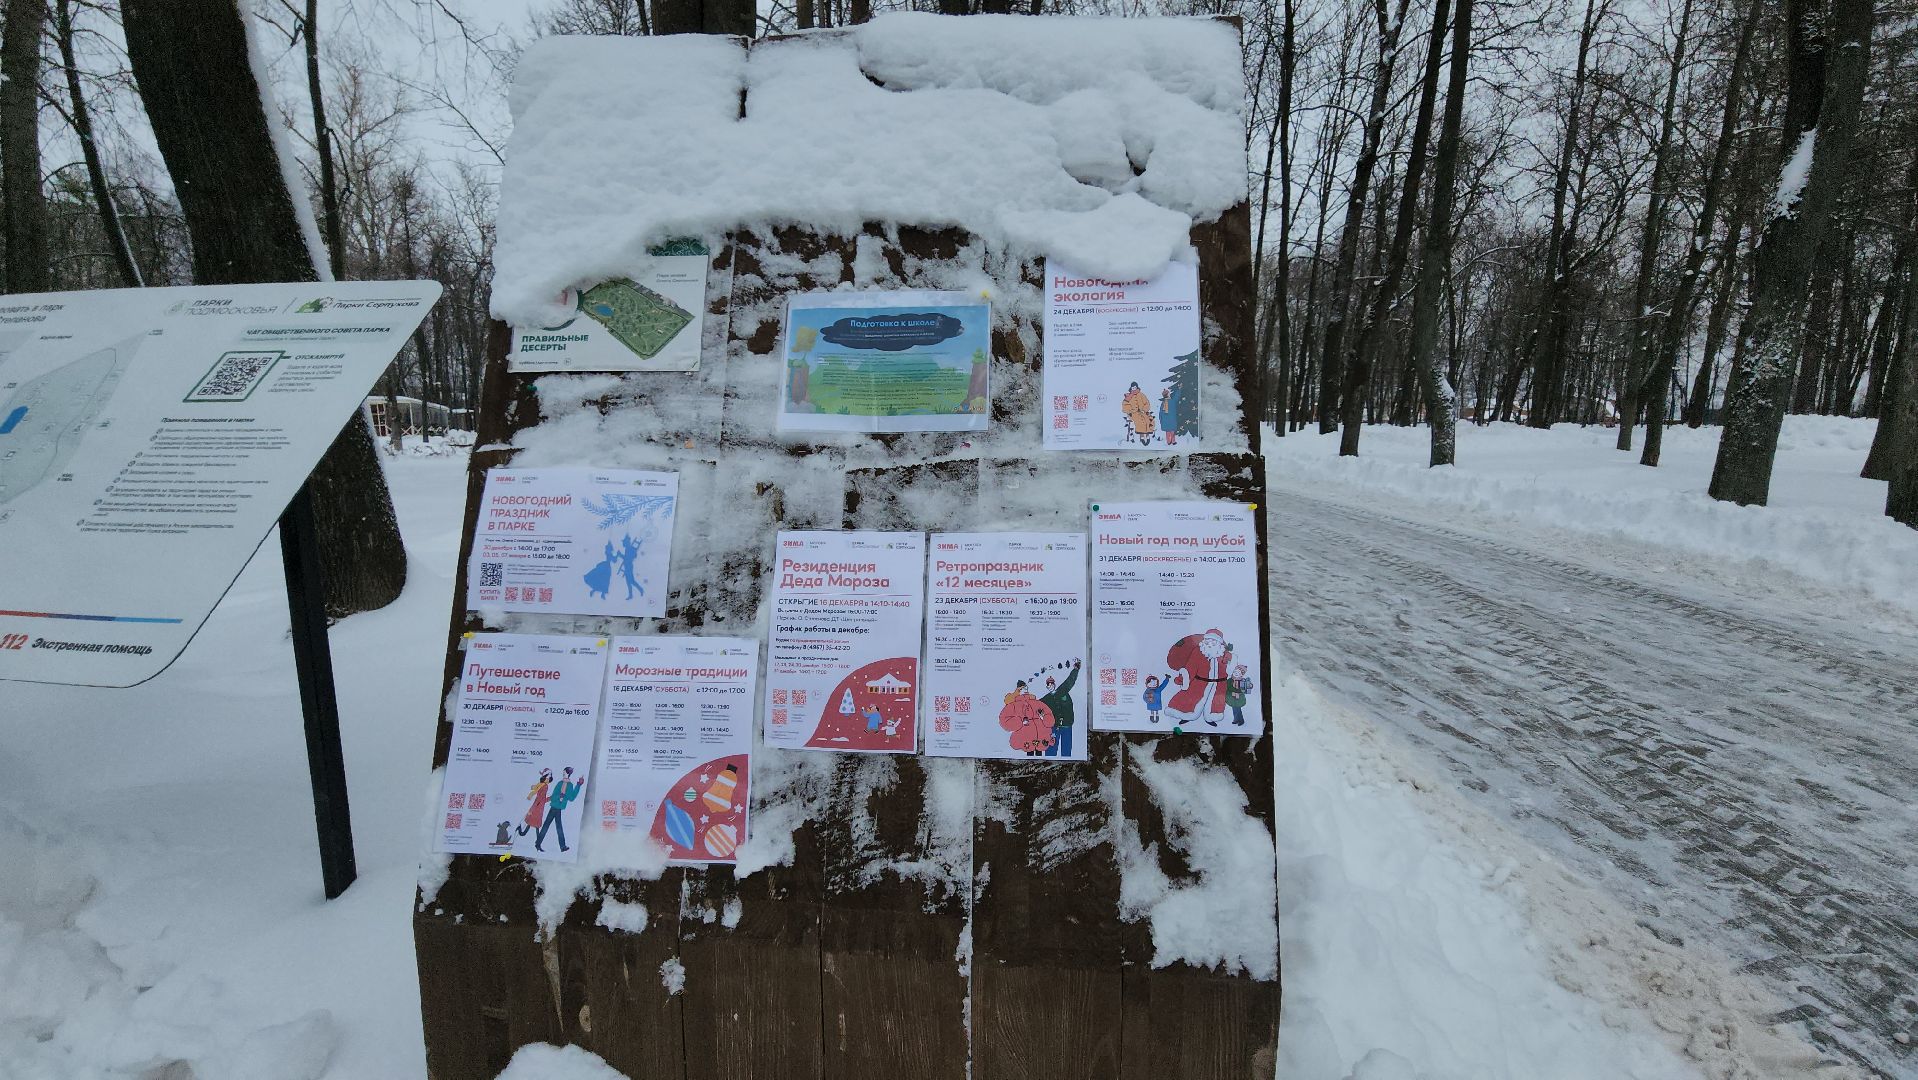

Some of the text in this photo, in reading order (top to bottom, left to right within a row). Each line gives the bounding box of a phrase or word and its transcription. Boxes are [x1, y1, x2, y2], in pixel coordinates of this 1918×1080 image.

[1054, 291, 1125, 303] экология
[184, 306, 278, 316] ПОДМОСКОВЬЯ
[850, 319, 899, 327] Подготовка
[522, 334, 589, 343] ПРАВИЛЬНЫЕ
[520, 343, 566, 352] ДЕСЕРТЫ
[492, 494, 572, 507] НОВОГОДНИЙ
[490, 509, 550, 520] ПРАЗДНИК
[487, 522, 535, 531] В ПАРКЕ
[1100, 534, 1245, 548] Новый год под шубой
[782, 559, 876, 575] Резиденция
[936, 560, 1043, 575] Ретропраздник
[780, 574, 890, 591] Деда Мороза
[936, 576, 1031, 590] «12 месяцев»
[776, 625, 802, 633] График
[31, 636, 103, 653] Экстренная
[102, 642, 153, 656] помощь
[468, 664, 561, 680] Путешествие
[615, 664, 748, 680] Морозные традиции
[466, 681, 546, 698] в Новый год
[654, 686, 689, 694] (СУББОТА)
[472, 703, 504, 711] ДЕКАБРЯ
[504, 705, 535, 713] (СУББОТА)
